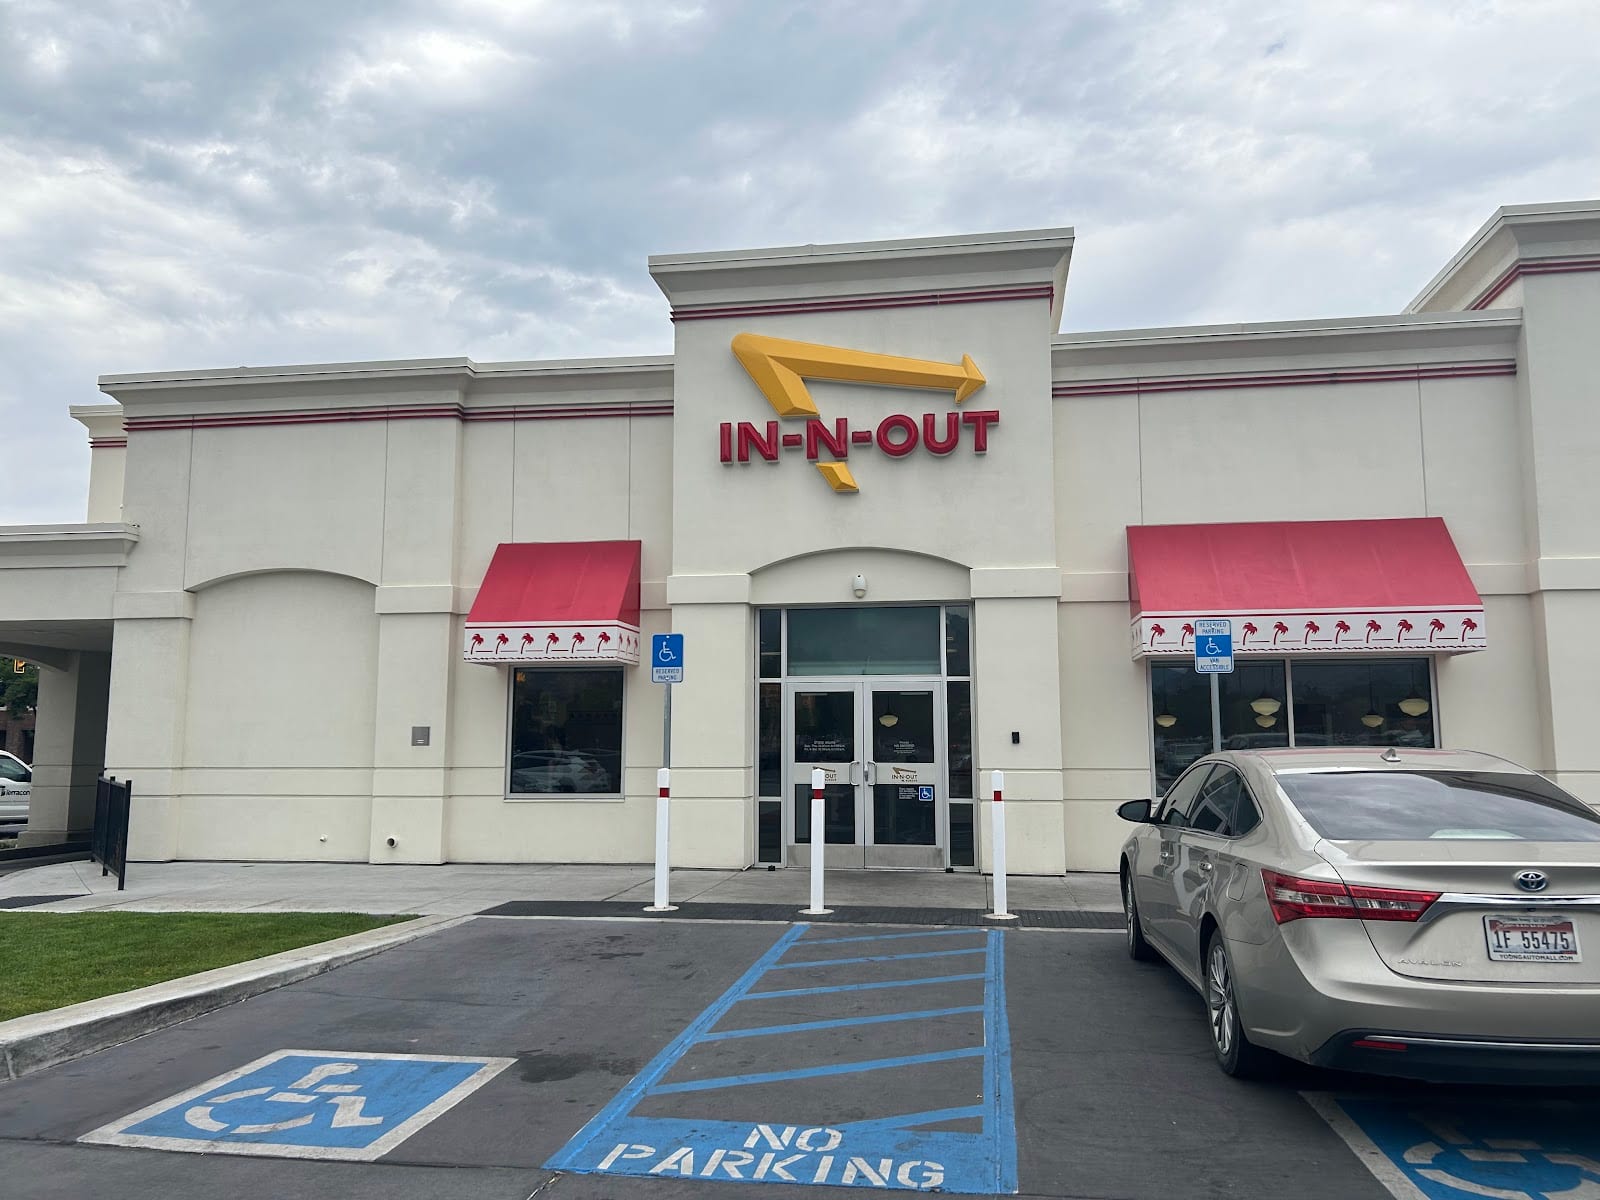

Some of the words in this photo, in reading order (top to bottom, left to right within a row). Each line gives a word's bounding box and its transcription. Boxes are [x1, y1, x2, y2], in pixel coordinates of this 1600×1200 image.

[719, 410, 1000, 464] IN-N-OUT
[1521, 931, 1570, 949] 55475
[744, 1124, 842, 1152] NO
[597, 1143, 945, 1188] PARKING
